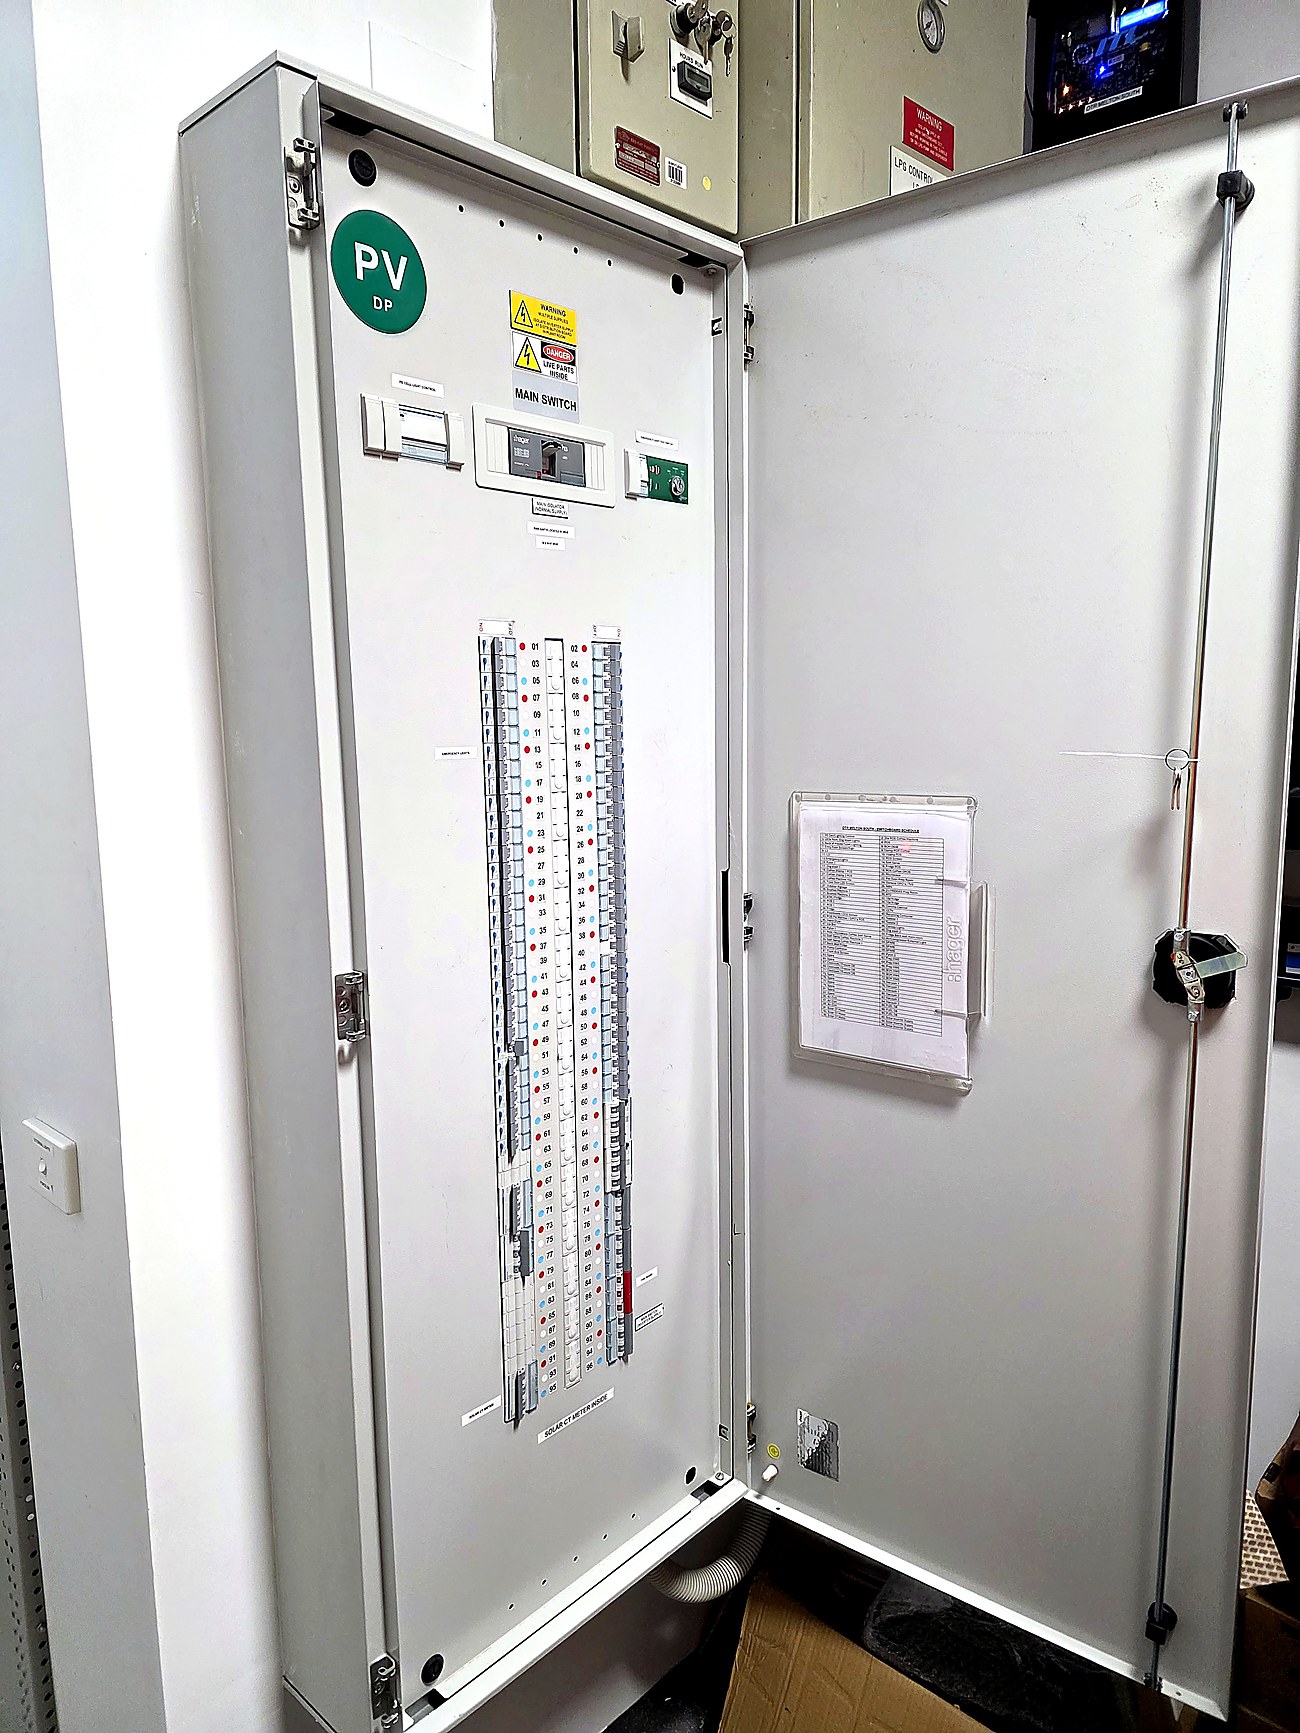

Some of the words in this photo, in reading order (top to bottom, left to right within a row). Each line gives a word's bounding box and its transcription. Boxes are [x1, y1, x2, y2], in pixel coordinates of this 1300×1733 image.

[917, 108, 942, 131] WARNING
[895, 157, 906, 171] LPG
[354, 241, 408, 291] PV
[373, 295, 392, 312] DP
[540, 304, 566, 317] WARNING
[546, 349, 570, 360] DANGER
[543, 361, 555, 369] LIVE
[557, 363, 574, 374] PARTS
[550, 370, 568, 380] INSIDE
[516, 388, 539, 403] MAIN
[542, 394, 576, 411] SWITCH
[942, 914, 965, 974] hager
[544, 1422, 563, 1438] SOLAR
[564, 1417, 571, 1425] CT
[572, 1404, 590, 1420] METER
[591, 1394, 608, 1408] INSIDE
